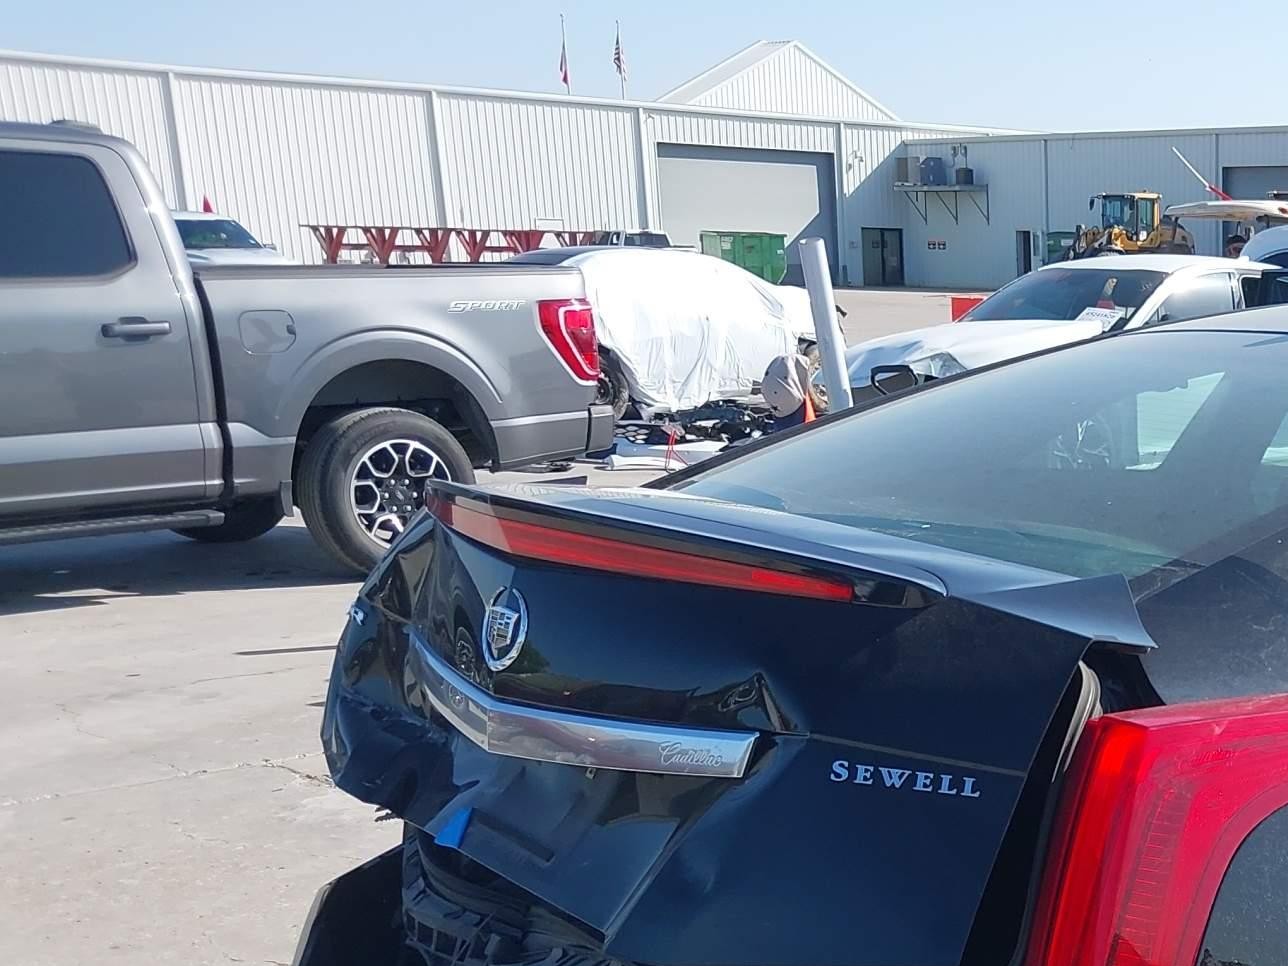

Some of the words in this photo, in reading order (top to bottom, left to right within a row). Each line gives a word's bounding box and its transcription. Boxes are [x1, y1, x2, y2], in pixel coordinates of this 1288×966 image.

[448, 299, 526, 313] SPORT
[658, 740, 722, 767] Cadillac
[830, 760, 981, 798] SEWELL
